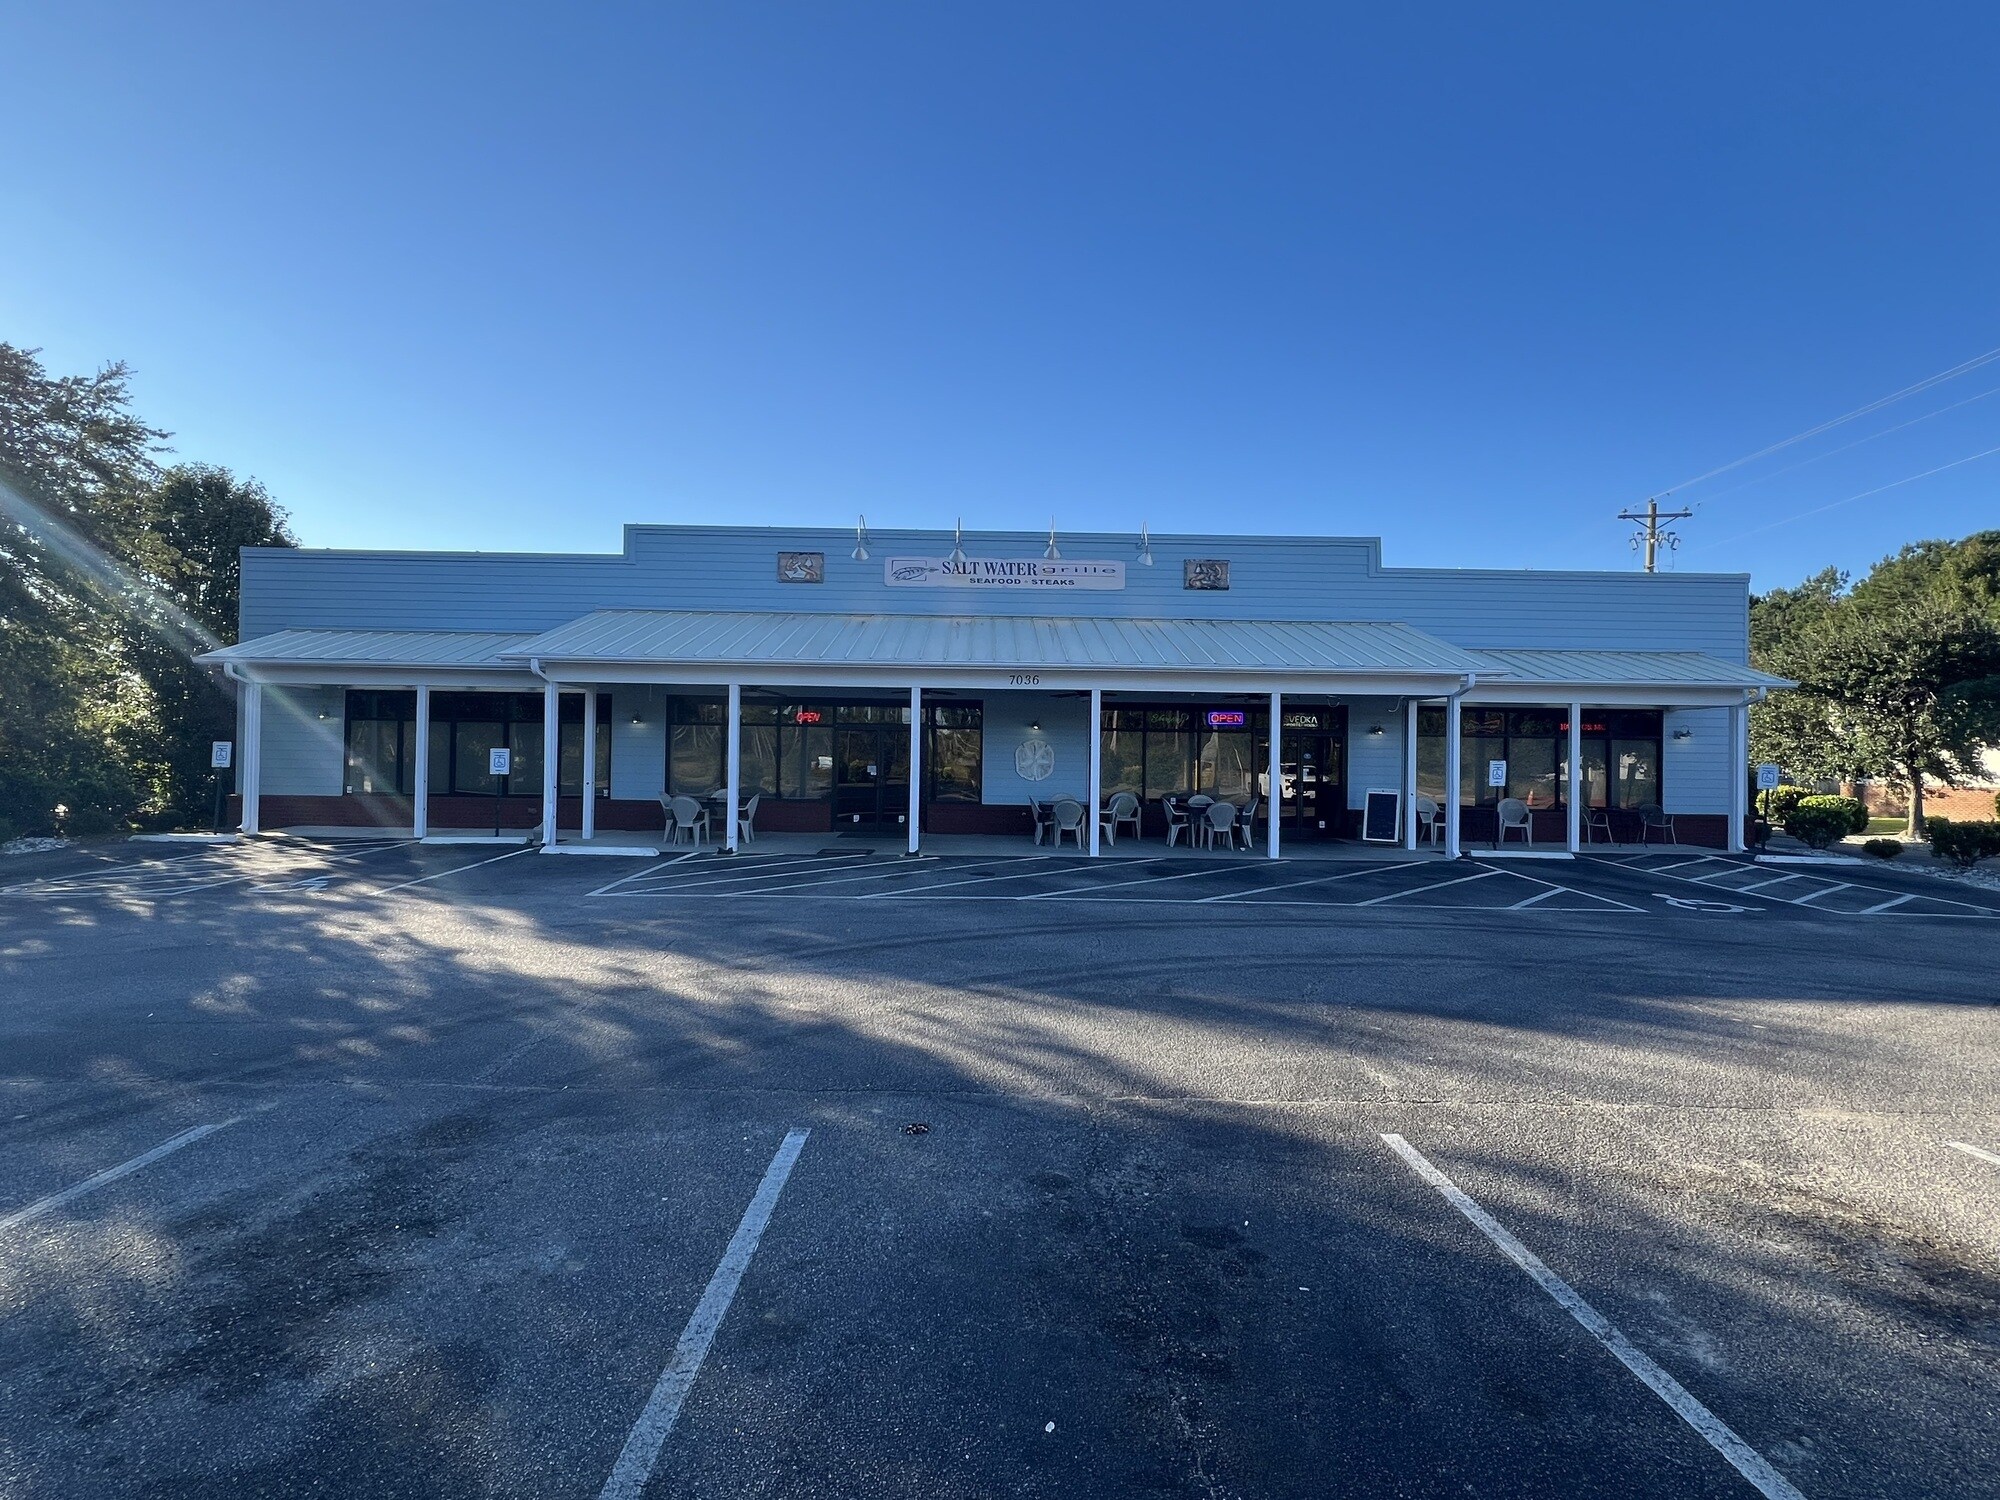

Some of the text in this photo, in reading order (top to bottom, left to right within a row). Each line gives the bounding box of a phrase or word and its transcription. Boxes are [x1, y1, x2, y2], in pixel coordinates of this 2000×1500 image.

[942, 561, 1116, 576] SALT WATER grille
[969, 577, 1021, 585] SEAFOOD
[1009, 674, 1039, 685] 7036
[796, 712, 820, 722] OPEN
[1210, 714, 1242, 723] OPEN
[1284, 715, 1318, 723] SVEDKA
